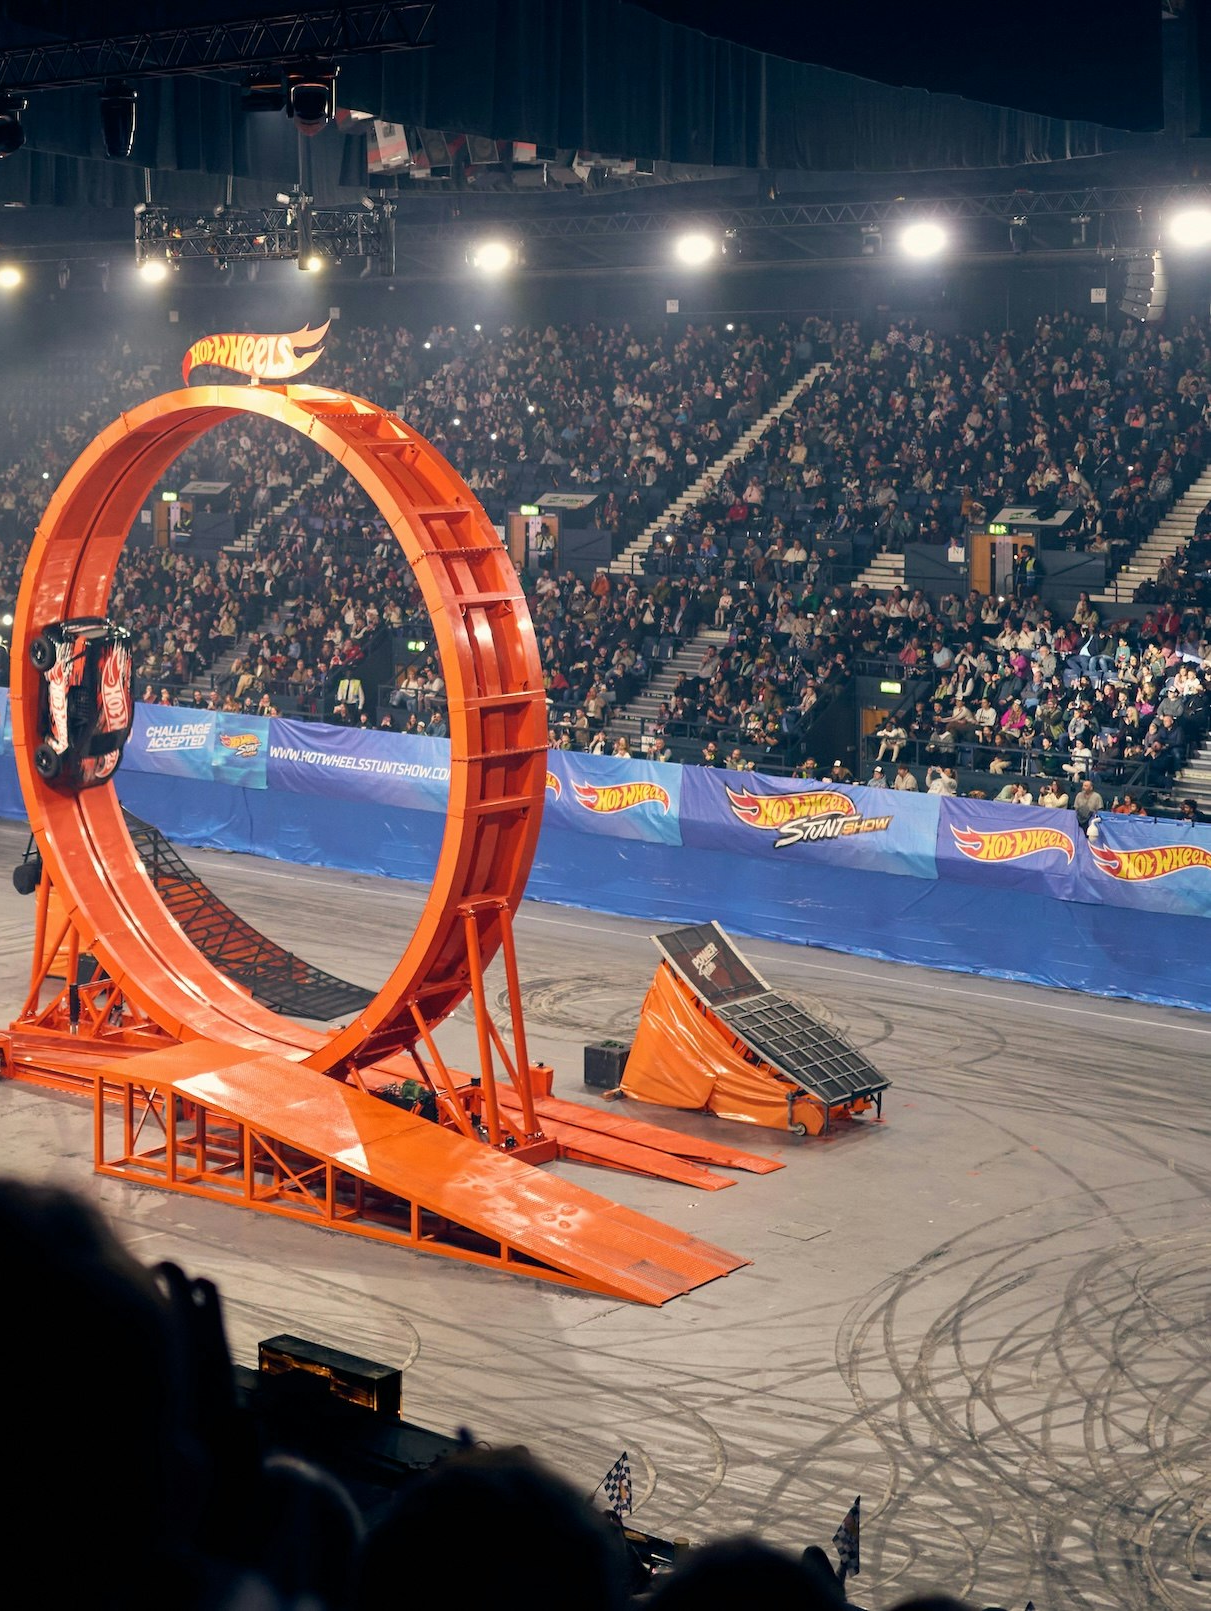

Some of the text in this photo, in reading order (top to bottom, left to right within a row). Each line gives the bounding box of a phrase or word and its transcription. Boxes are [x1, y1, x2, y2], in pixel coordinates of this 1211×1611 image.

[211, 335, 294, 376] WHEELS
[146, 723, 212, 738] CHALLENGE
[147, 735, 207, 749] ACCEPTED
[621, 784, 666, 808] WHEELS
[791, 793, 849, 819] WHEELS
[775, 815, 890, 848] STUNT SHOW
[1012, 830, 1069, 857] WHEELS
[692, 942, 718, 969] POWER
